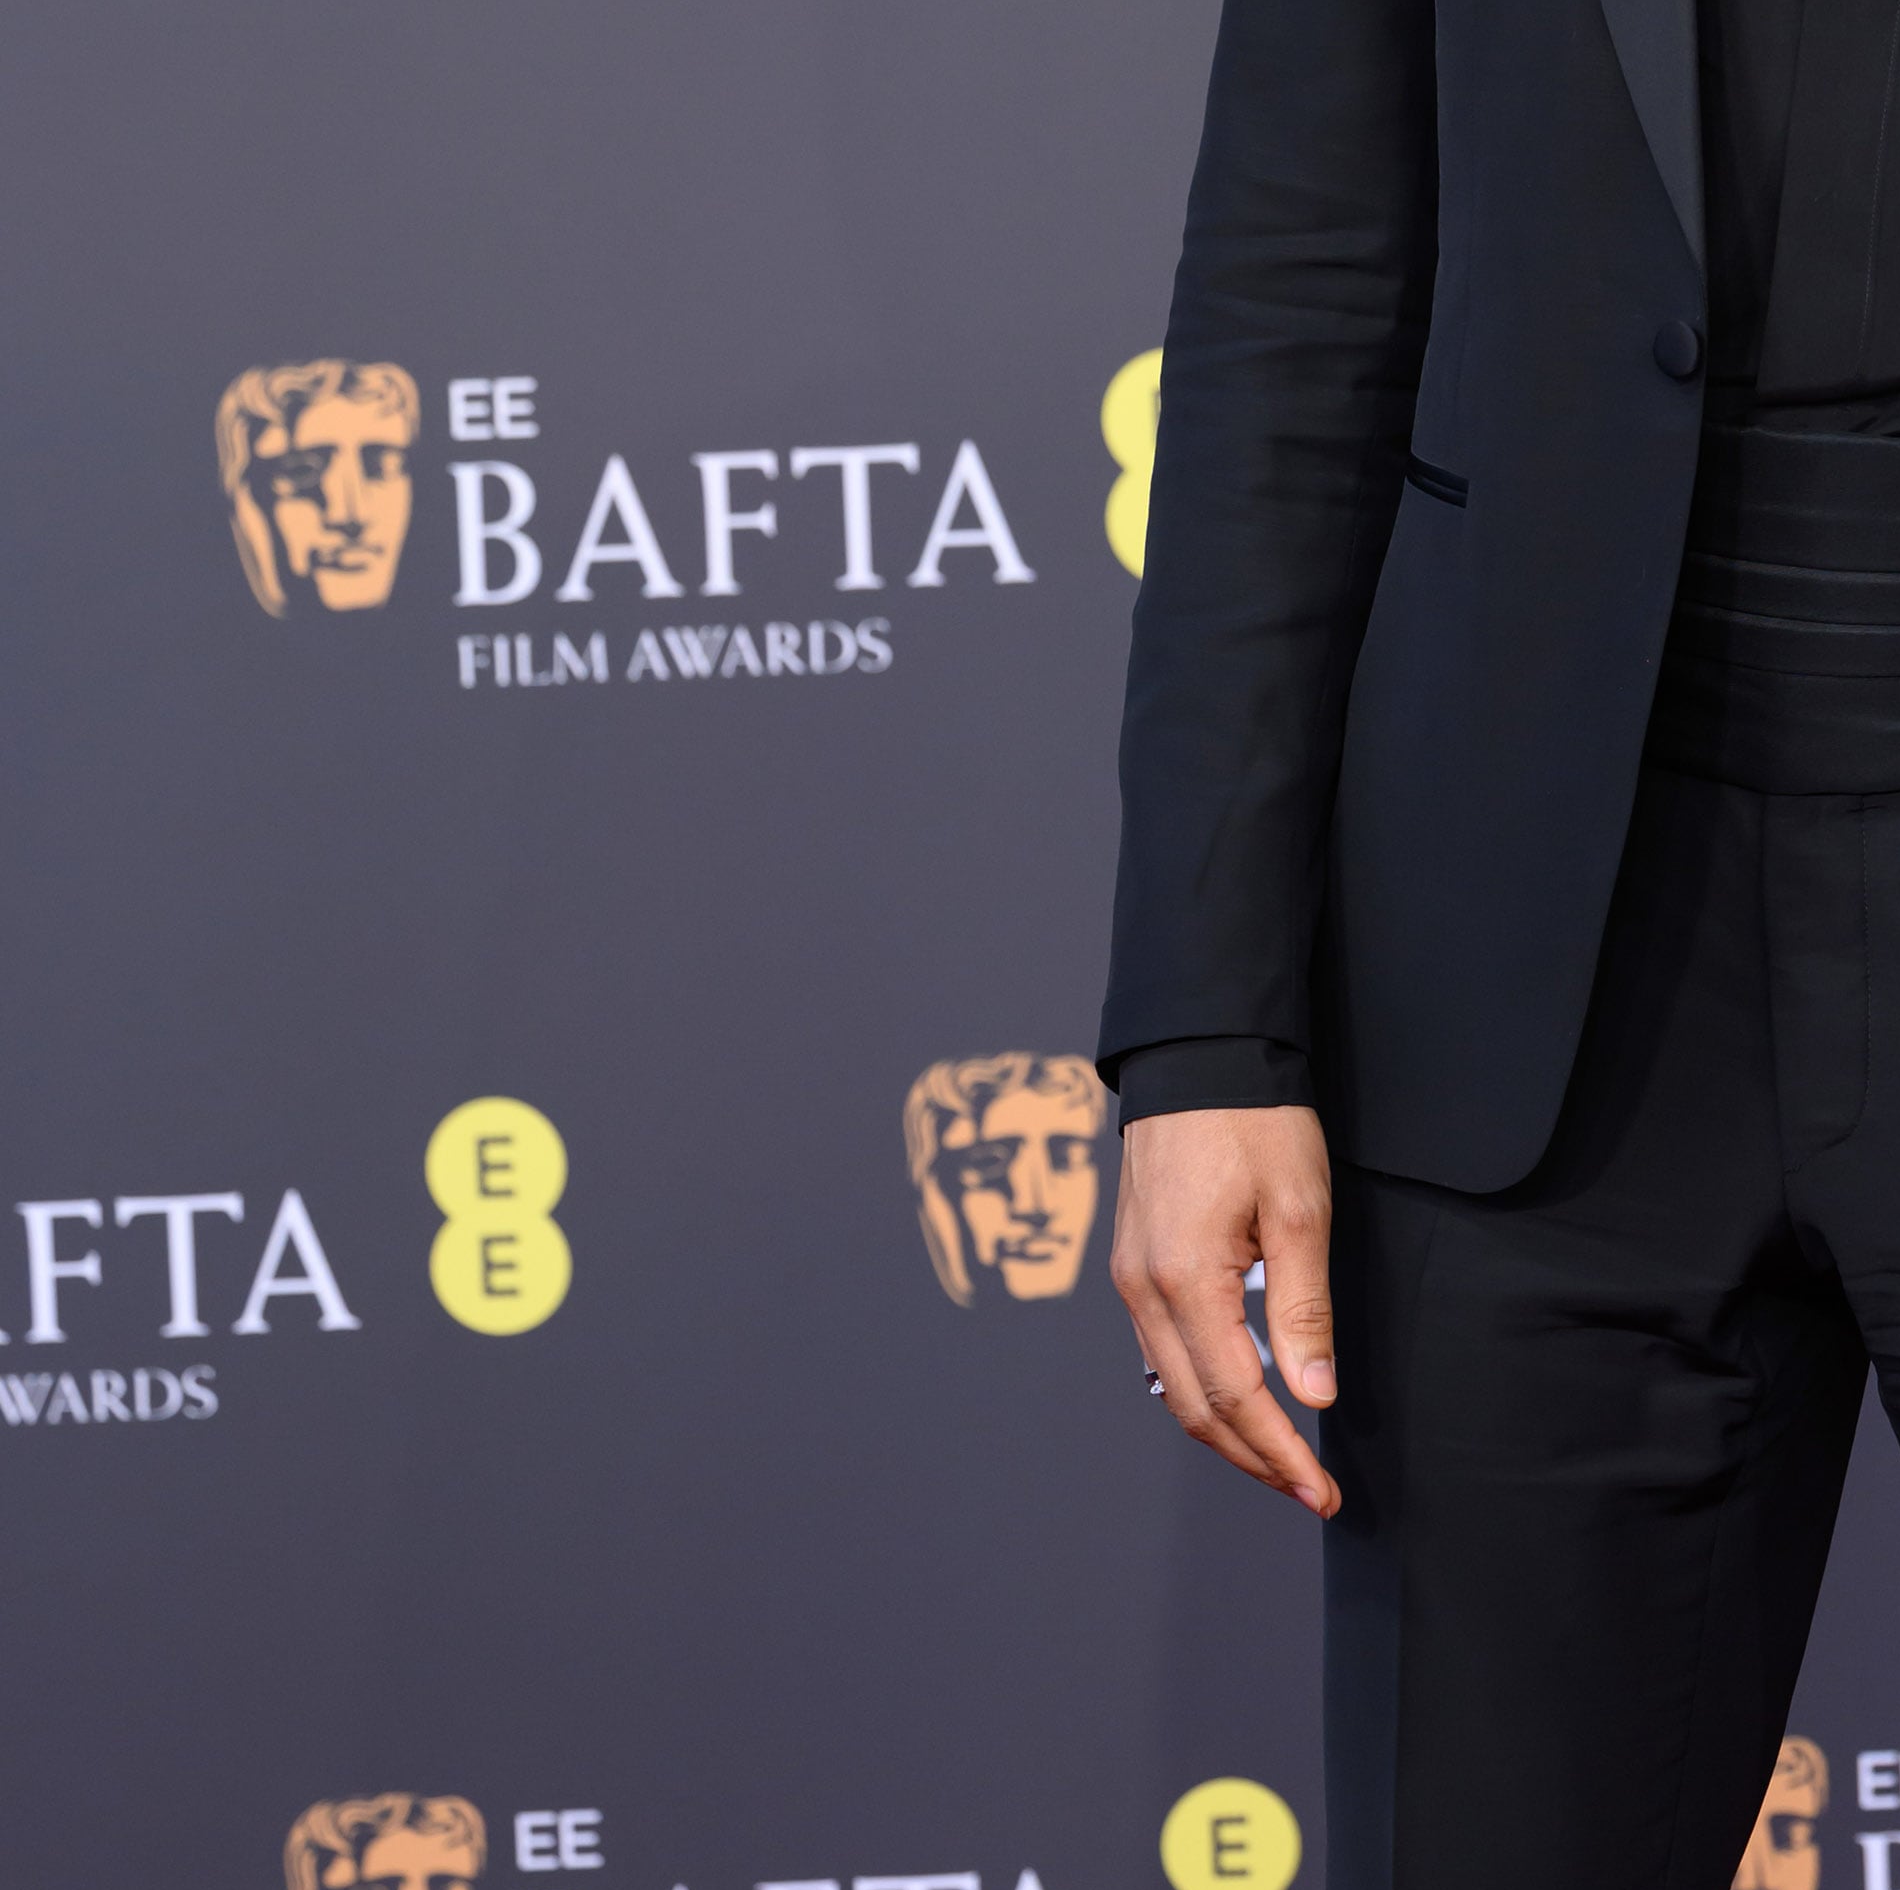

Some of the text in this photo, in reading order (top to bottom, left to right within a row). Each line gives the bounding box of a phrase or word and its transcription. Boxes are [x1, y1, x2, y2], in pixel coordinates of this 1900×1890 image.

[448, 376, 539, 441] EE
[448, 439, 1036, 607] BAFTA
[457, 618, 893, 689] FILM AWARDS
[0, 1187, 362, 1346] FTA
[514, 1808, 605, 1872] EE
